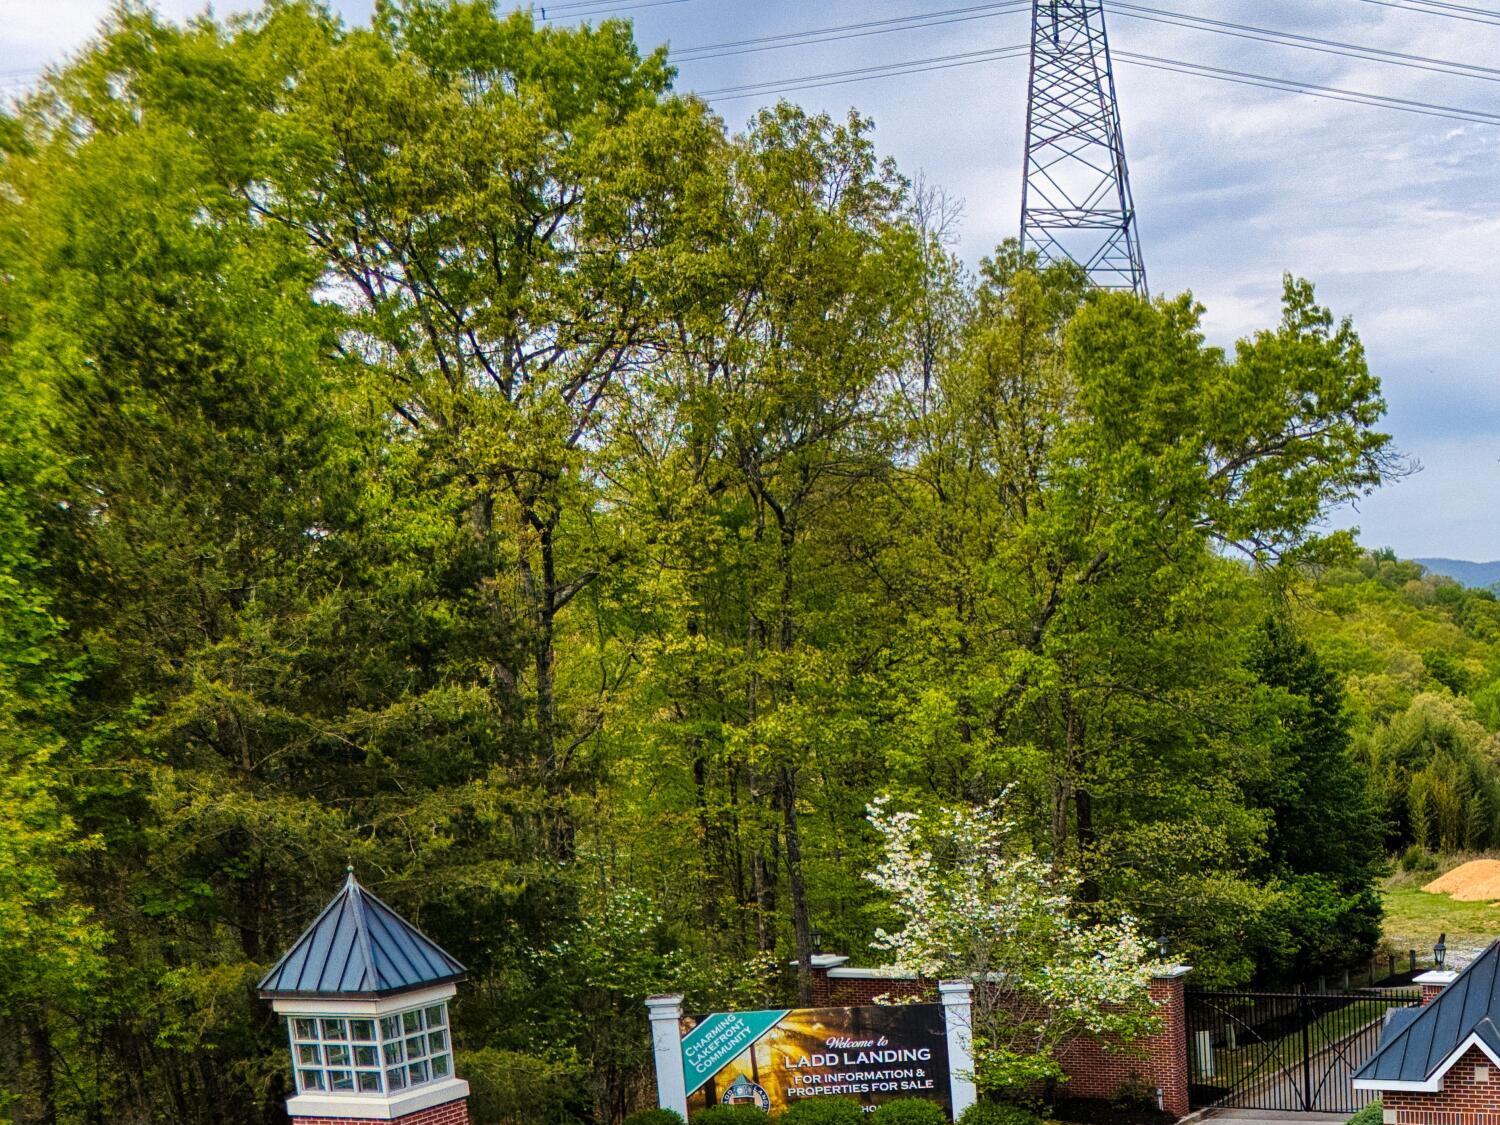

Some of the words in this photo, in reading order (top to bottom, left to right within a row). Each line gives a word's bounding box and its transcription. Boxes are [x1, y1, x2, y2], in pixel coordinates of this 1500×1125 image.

[685, 1014, 736, 1057] CHARMING
[688, 1018, 745, 1066] LAKEFRONT
[826, 1036, 874, 1049] Welcome
[877, 1035, 888, 1047] to
[696, 1026, 751, 1073] COMMUNITY
[785, 1053, 839, 1069] LADD
[843, 1048, 931, 1065] LANDING
[794, 1074, 821, 1085] FOR
[824, 1069, 913, 1083] INFORMATION
[915, 1068, 926, 1078] &
[788, 1083, 869, 1097] PROPERTIES
[871, 1081, 898, 1092] FOR
[900, 1079, 935, 1090] SALE
